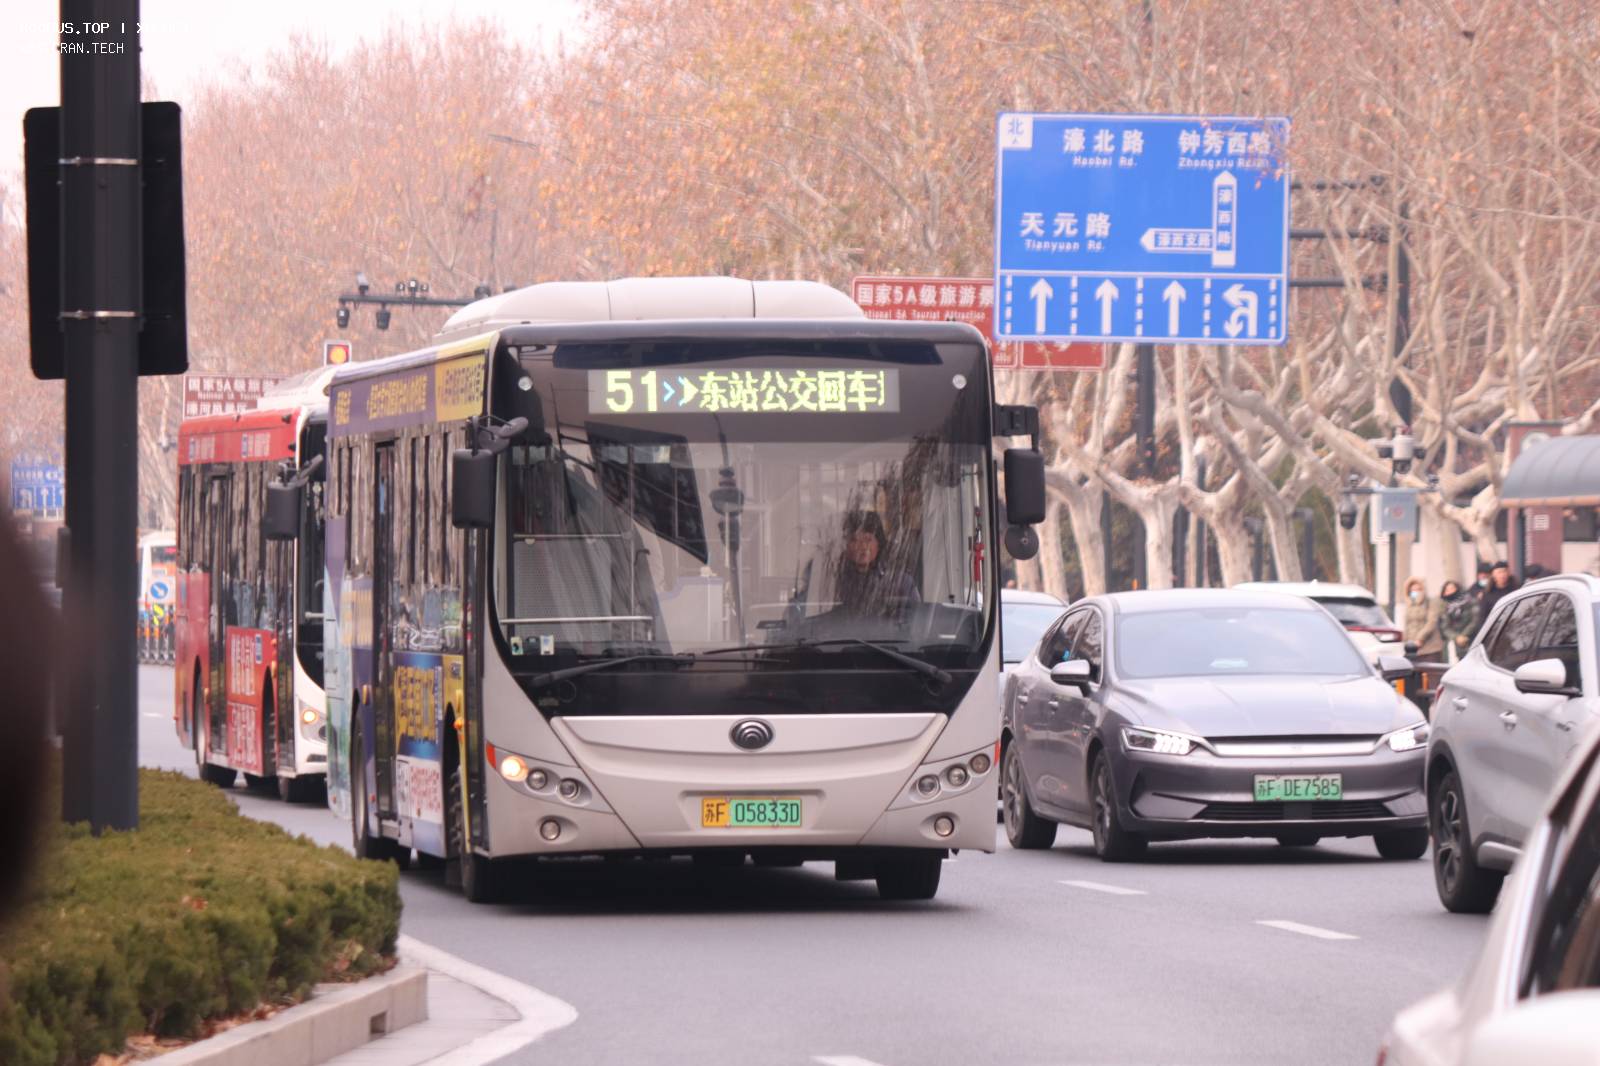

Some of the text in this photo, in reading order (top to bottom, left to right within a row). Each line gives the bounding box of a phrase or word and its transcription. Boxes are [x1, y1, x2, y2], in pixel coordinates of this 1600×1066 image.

[1007, 118, 1024, 135] 北
[1063, 127, 1145, 154] 濠北路
[1073, 155, 1112, 167] Haobei
[1178, 157, 1234, 170] Zhongxiu
[1019, 211, 1112, 239] 天元路
[1024, 238, 1080, 253] Tianyuan
[605, 370, 658, 412] 51
[1283, 778, 1340, 797] DE7585
[705, 802, 800, 823] 苏F 05833D
